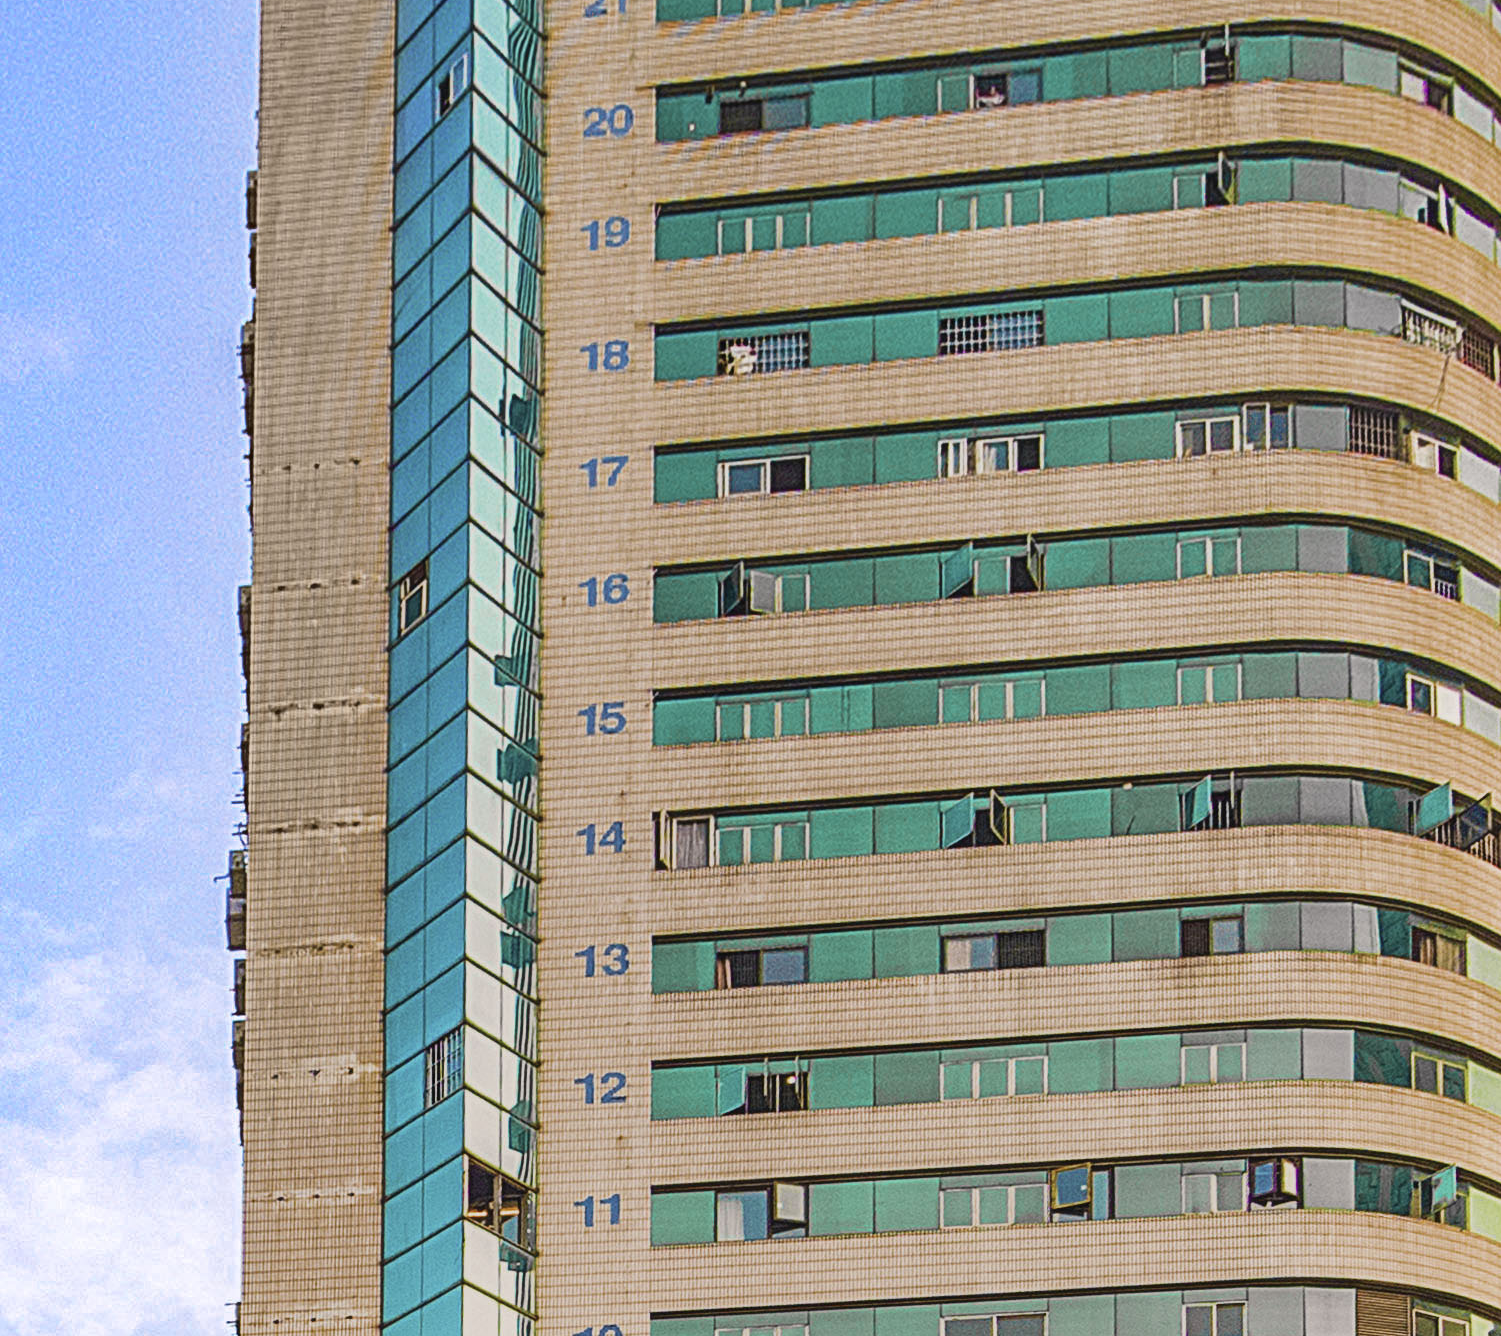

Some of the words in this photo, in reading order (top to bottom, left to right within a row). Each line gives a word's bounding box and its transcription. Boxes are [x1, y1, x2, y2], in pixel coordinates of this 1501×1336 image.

[582, 106, 634, 138] 20
[580, 216, 631, 249] 19
[580, 341, 630, 373] 18
[580, 457, 629, 488] 17
[579, 574, 630, 606] 16
[577, 701, 628, 736] 15
[576, 822, 627, 855] 14
[575, 944, 630, 978] 13
[574, 1072, 627, 1104] 12
[574, 1195, 623, 1227] 11
